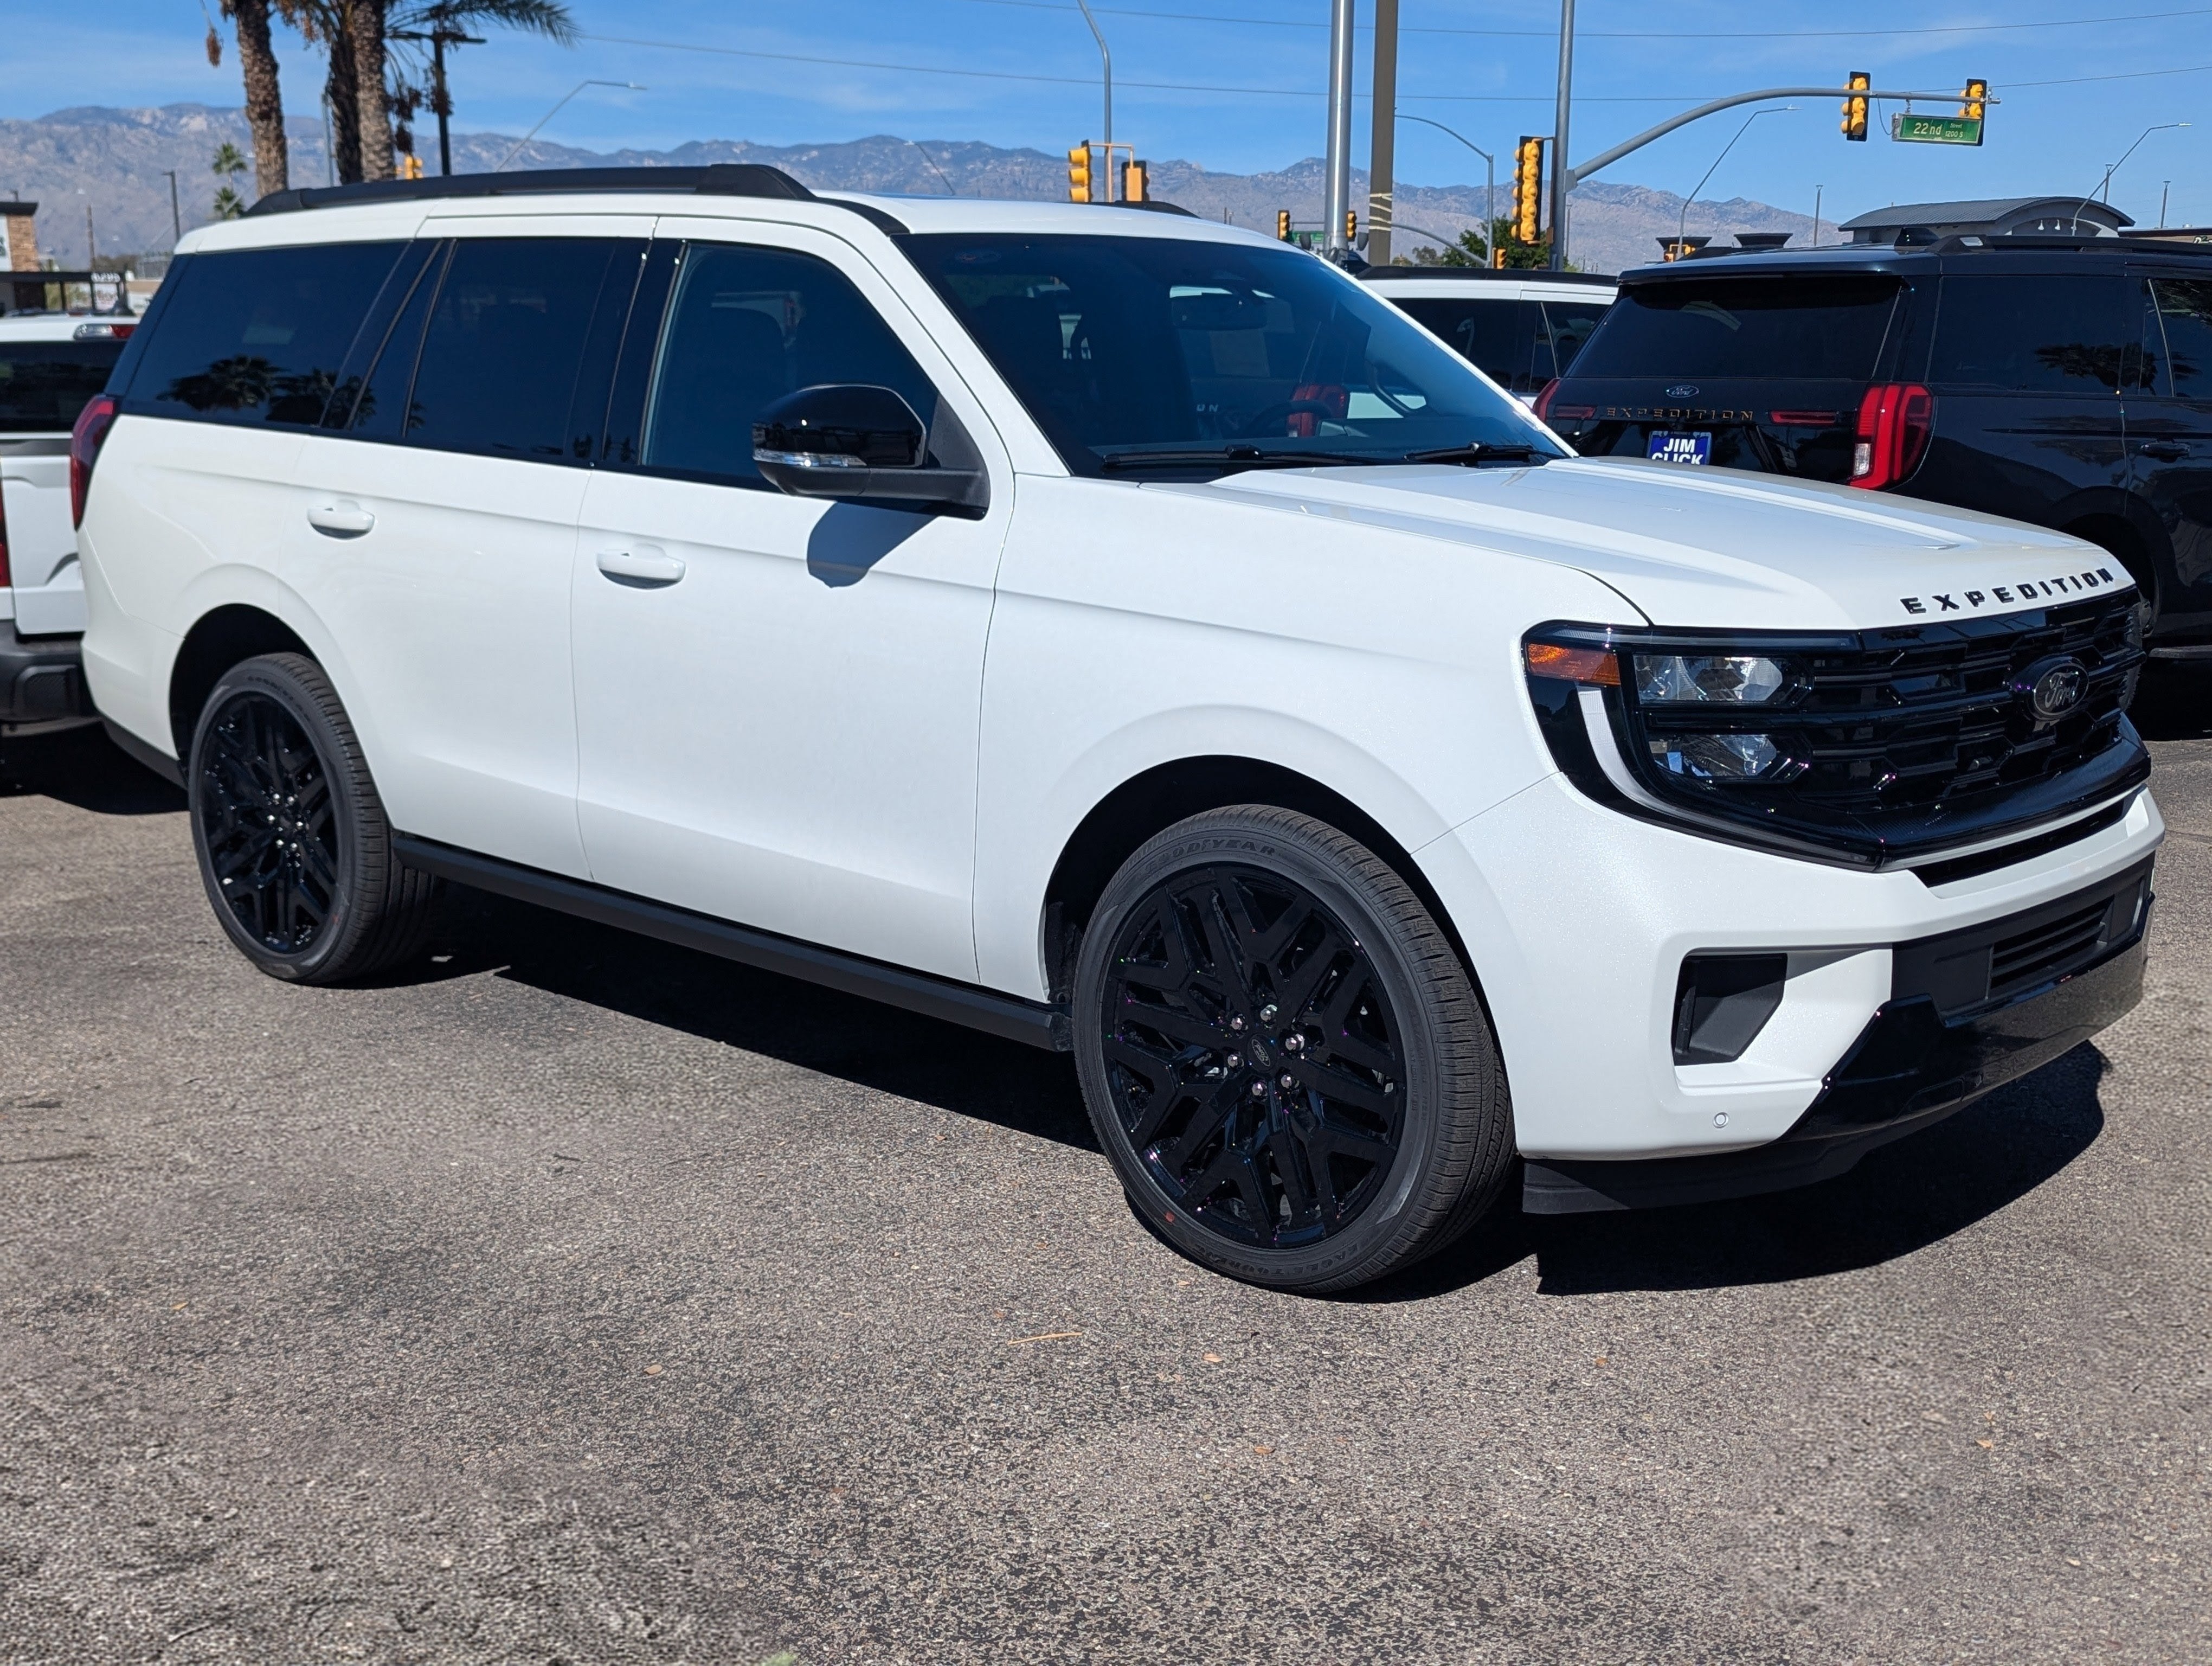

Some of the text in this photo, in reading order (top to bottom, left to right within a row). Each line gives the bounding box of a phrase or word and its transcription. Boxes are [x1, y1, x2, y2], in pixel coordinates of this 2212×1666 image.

[1913, 122, 1943, 135] 22nd
[1671, 385, 1693, 396] Ford
[1606, 407, 1753, 421] EXPEDITION
[1663, 438, 1695, 452] JIM
[1900, 568, 2114, 614] EXPEDITION
[2044, 671, 2080, 708] Ford
